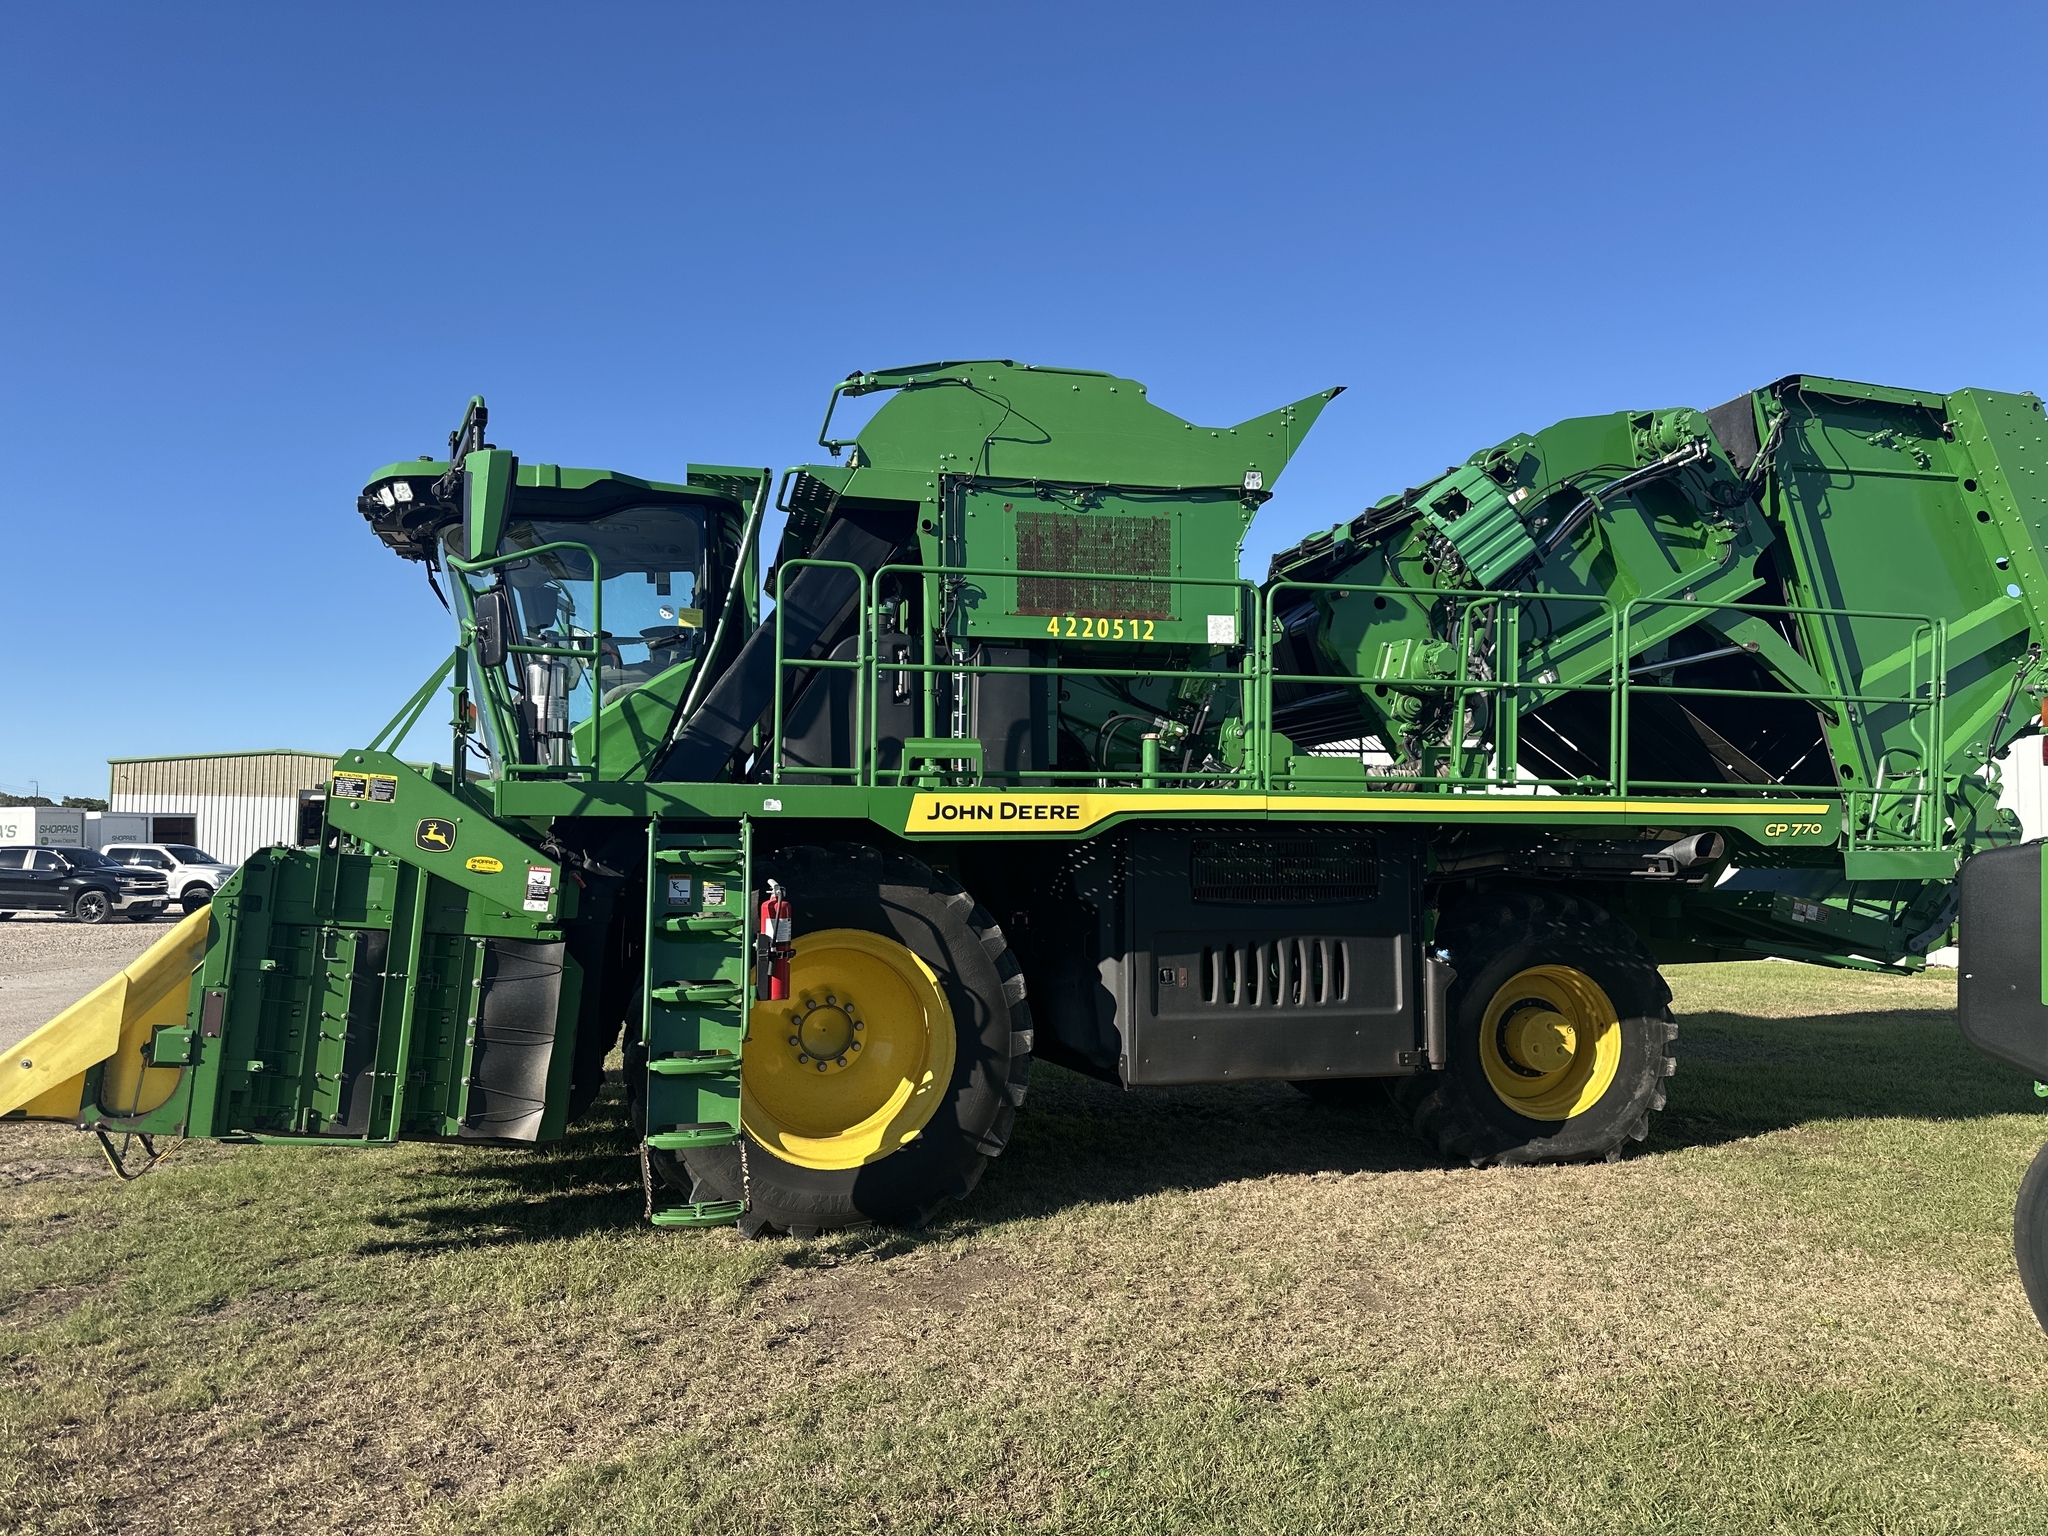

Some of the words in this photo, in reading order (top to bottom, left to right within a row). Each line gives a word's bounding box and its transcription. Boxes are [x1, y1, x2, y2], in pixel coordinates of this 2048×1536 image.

[1046, 616, 1155, 641] 4220512
[927, 802, 993, 820] JOHN
[999, 803, 1080, 820] DEERE
[39, 824, 79, 834] SHOPPA'S
[1765, 823, 1788, 837] CP
[1790, 823, 1823, 837] 770
